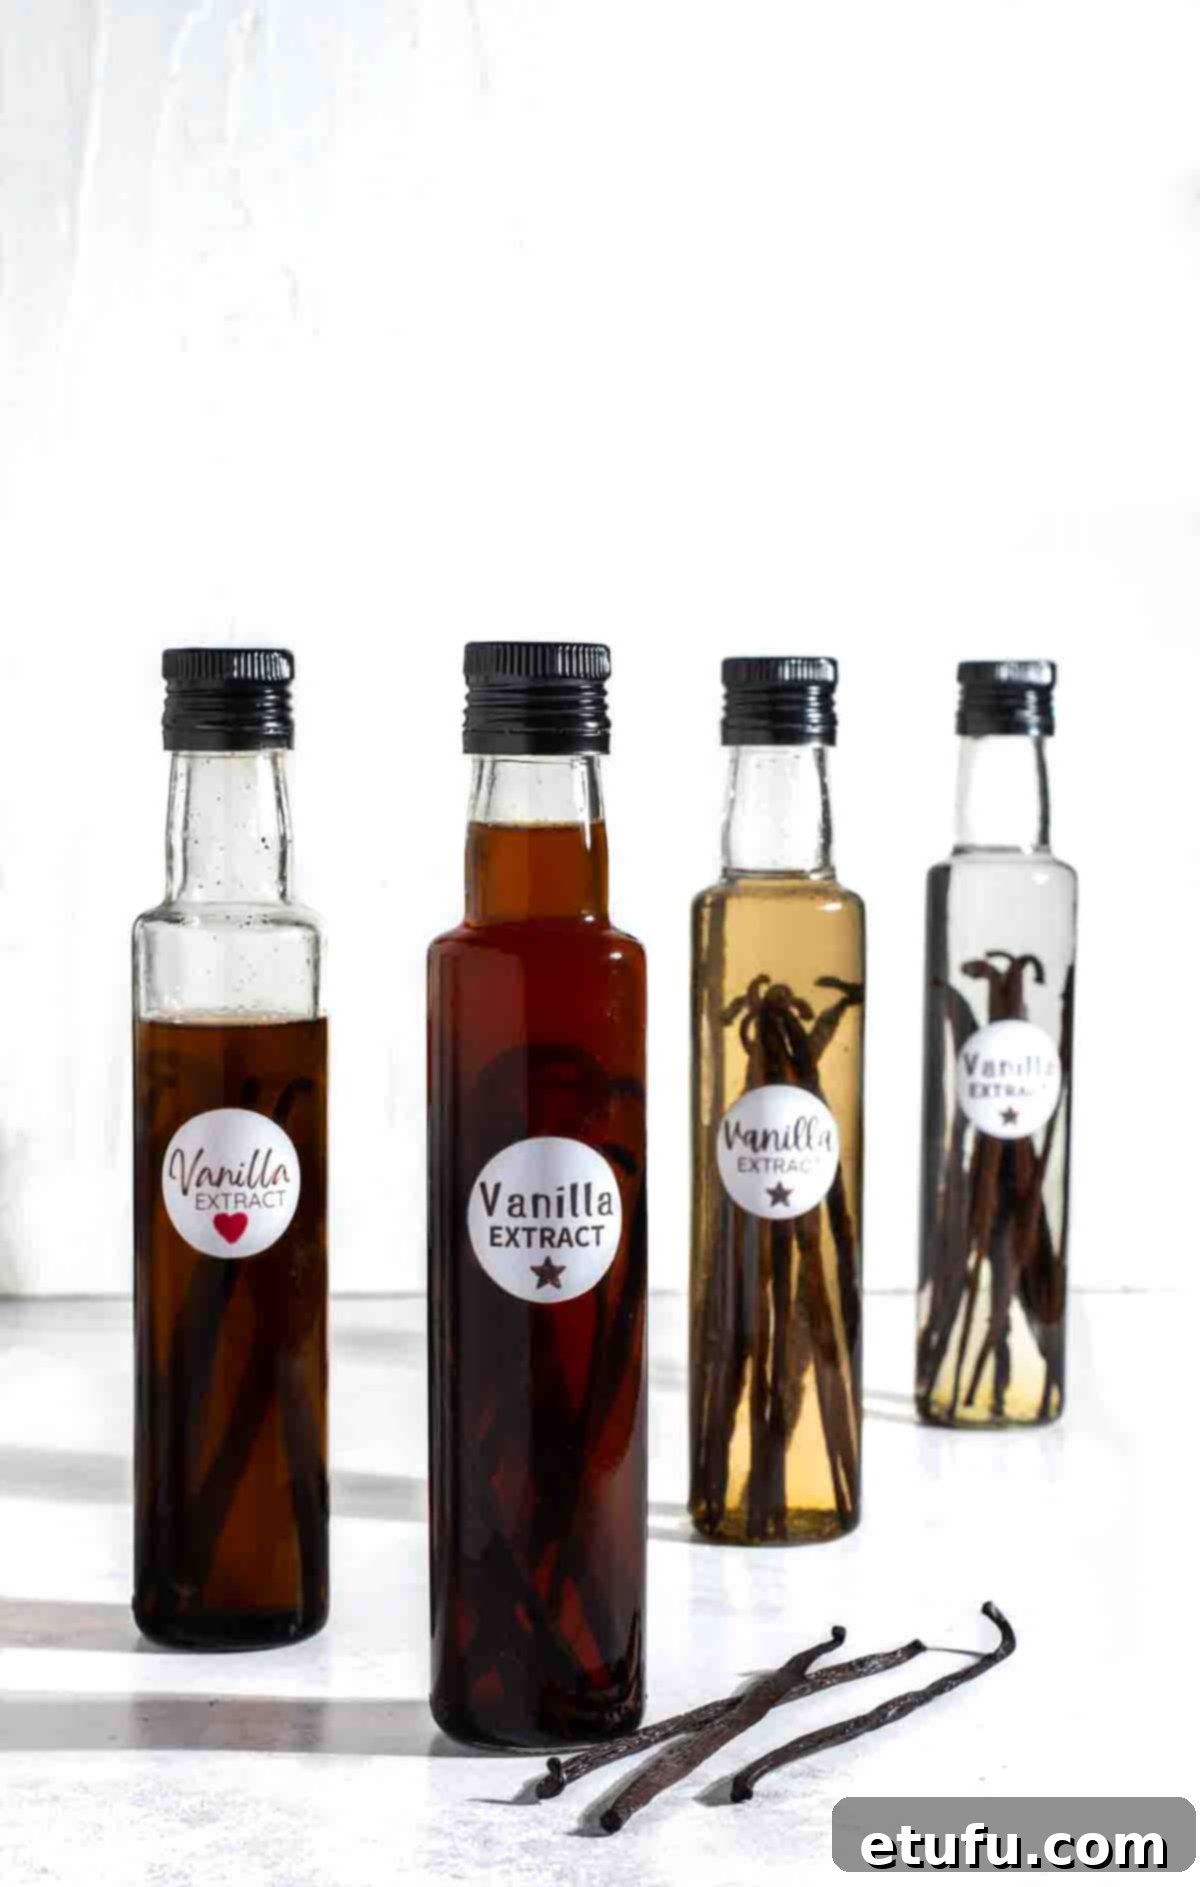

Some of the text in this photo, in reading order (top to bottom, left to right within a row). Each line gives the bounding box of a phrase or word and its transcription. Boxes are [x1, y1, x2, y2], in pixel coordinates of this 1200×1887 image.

[968, 1082, 1046, 1098] EXTRA
[725, 1116, 831, 1153] Vanilla
[169, 1148, 290, 1196] Vanilla
[737, 1157, 821, 1174] EXTRAC
[195, 1190, 286, 1211] EXTRACT
[480, 1181, 613, 1219] Vanilla
[490, 1225, 605, 1248] EXTRACT
